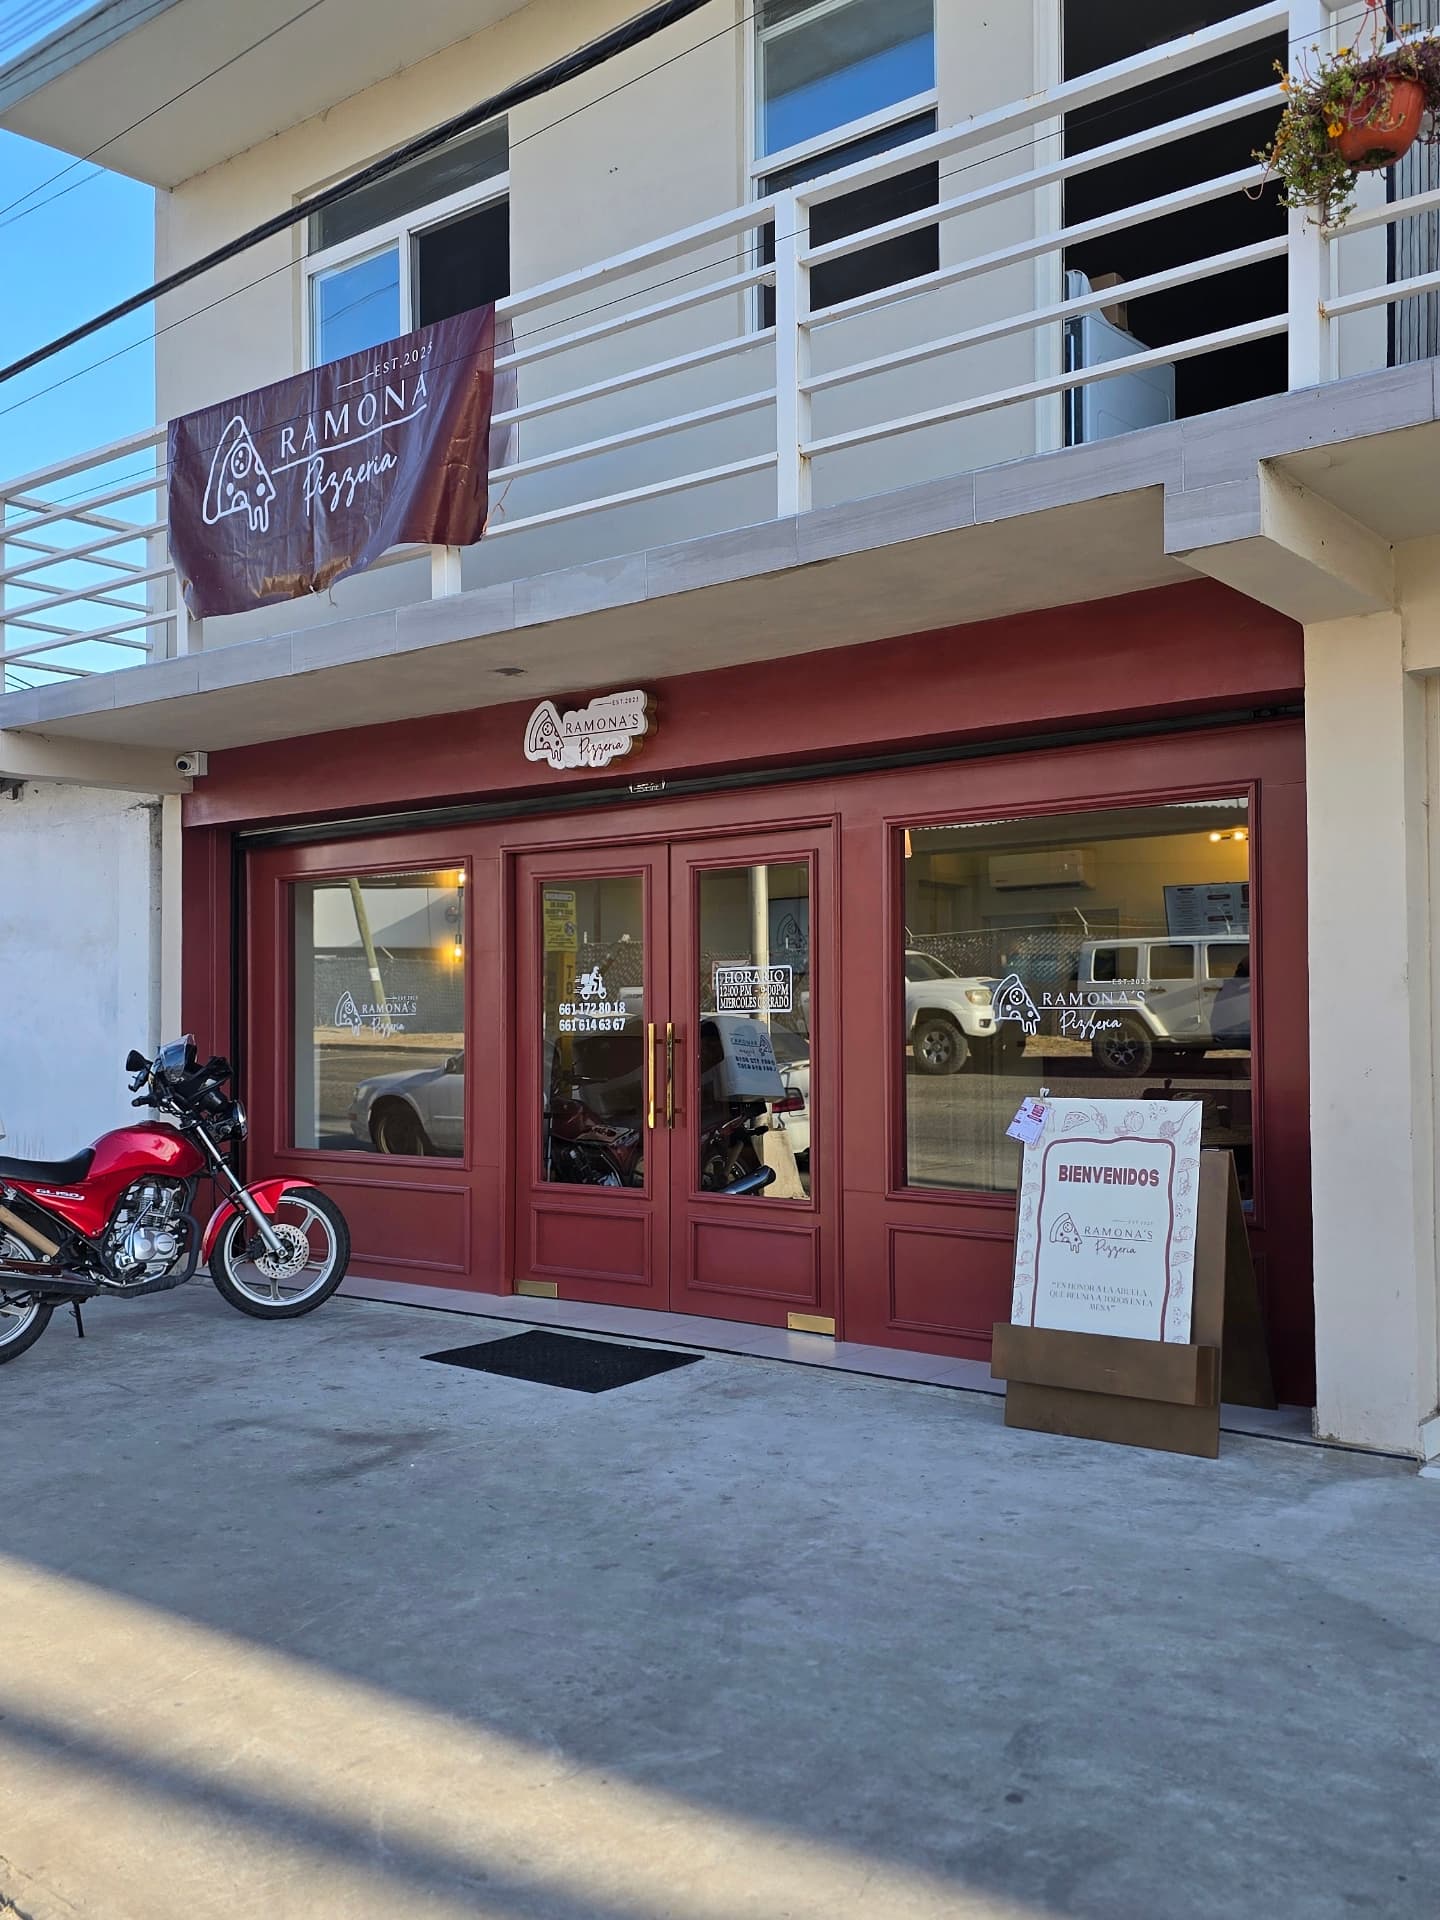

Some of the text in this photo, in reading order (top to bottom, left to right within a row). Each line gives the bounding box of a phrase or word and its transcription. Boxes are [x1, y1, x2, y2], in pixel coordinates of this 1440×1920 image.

[281, 373, 428, 459] RAMONA
[303, 452, 398, 517] Pizzeria
[565, 713, 639, 734] RAMONA'S
[579, 737, 624, 760] Pizzeria
[719, 985, 739, 997] 12:00
[740, 984, 753, 996] PM
[1043, 990, 1146, 1006] RAMONA'S
[559, 1001, 626, 1016] 661 172 80 18
[719, 996, 789, 1009] MIERCOLES CRADO
[559, 1017, 626, 1032] 661 614 63 67
[1060, 1010, 1123, 1039] Pizzeria
[1058, 1165, 1160, 1187] BIENVENIDOS
[1084, 1226, 1153, 1239] RAMONA'S
[1095, 1239, 1137, 1259] Pizzeria
